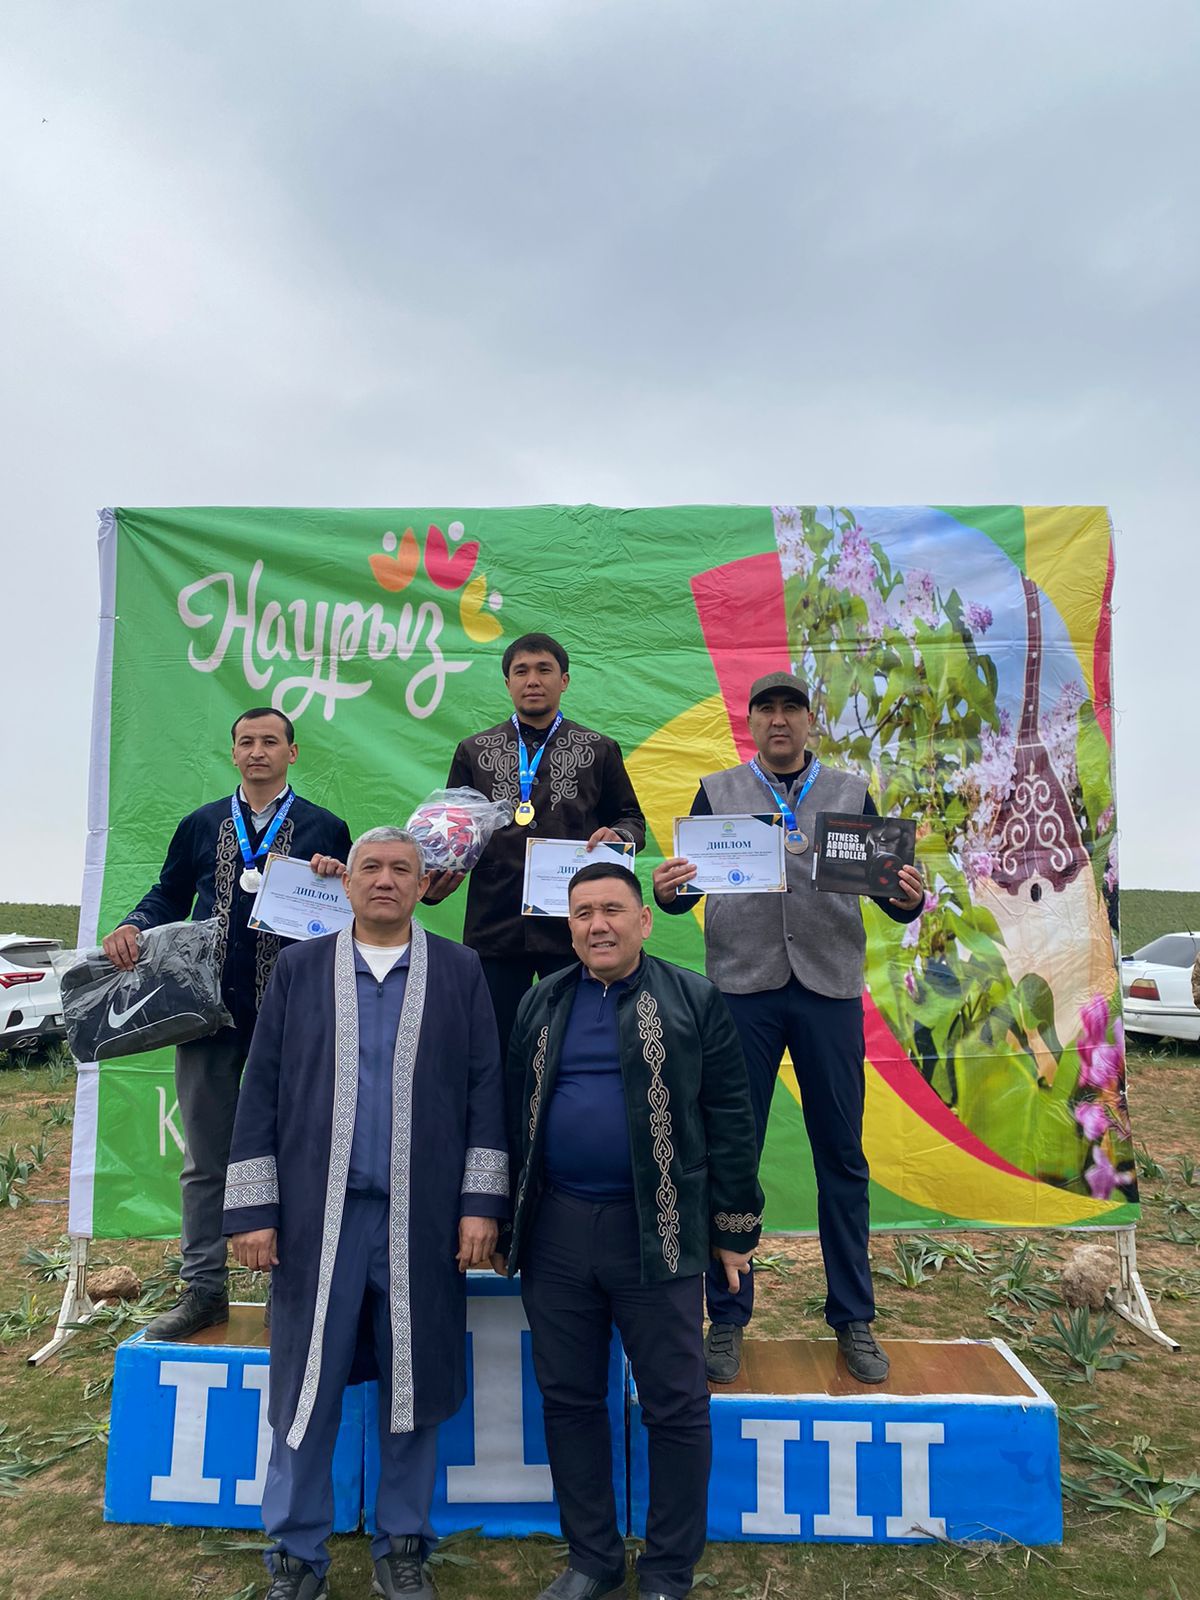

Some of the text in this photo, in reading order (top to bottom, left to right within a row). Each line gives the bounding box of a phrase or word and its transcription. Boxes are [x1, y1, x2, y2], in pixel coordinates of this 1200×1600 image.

[177, 559, 473, 721] Наурыз
[827, 832, 860, 843] FITNESS
[706, 840, 752, 850] ДИПЛОМ
[826, 841, 866, 852] ABDOMEN
[826, 849, 867, 860] AB ROLLER
[293, 886, 339, 903] ДИПЛОМ
[741, 1418, 947, 1538] III
